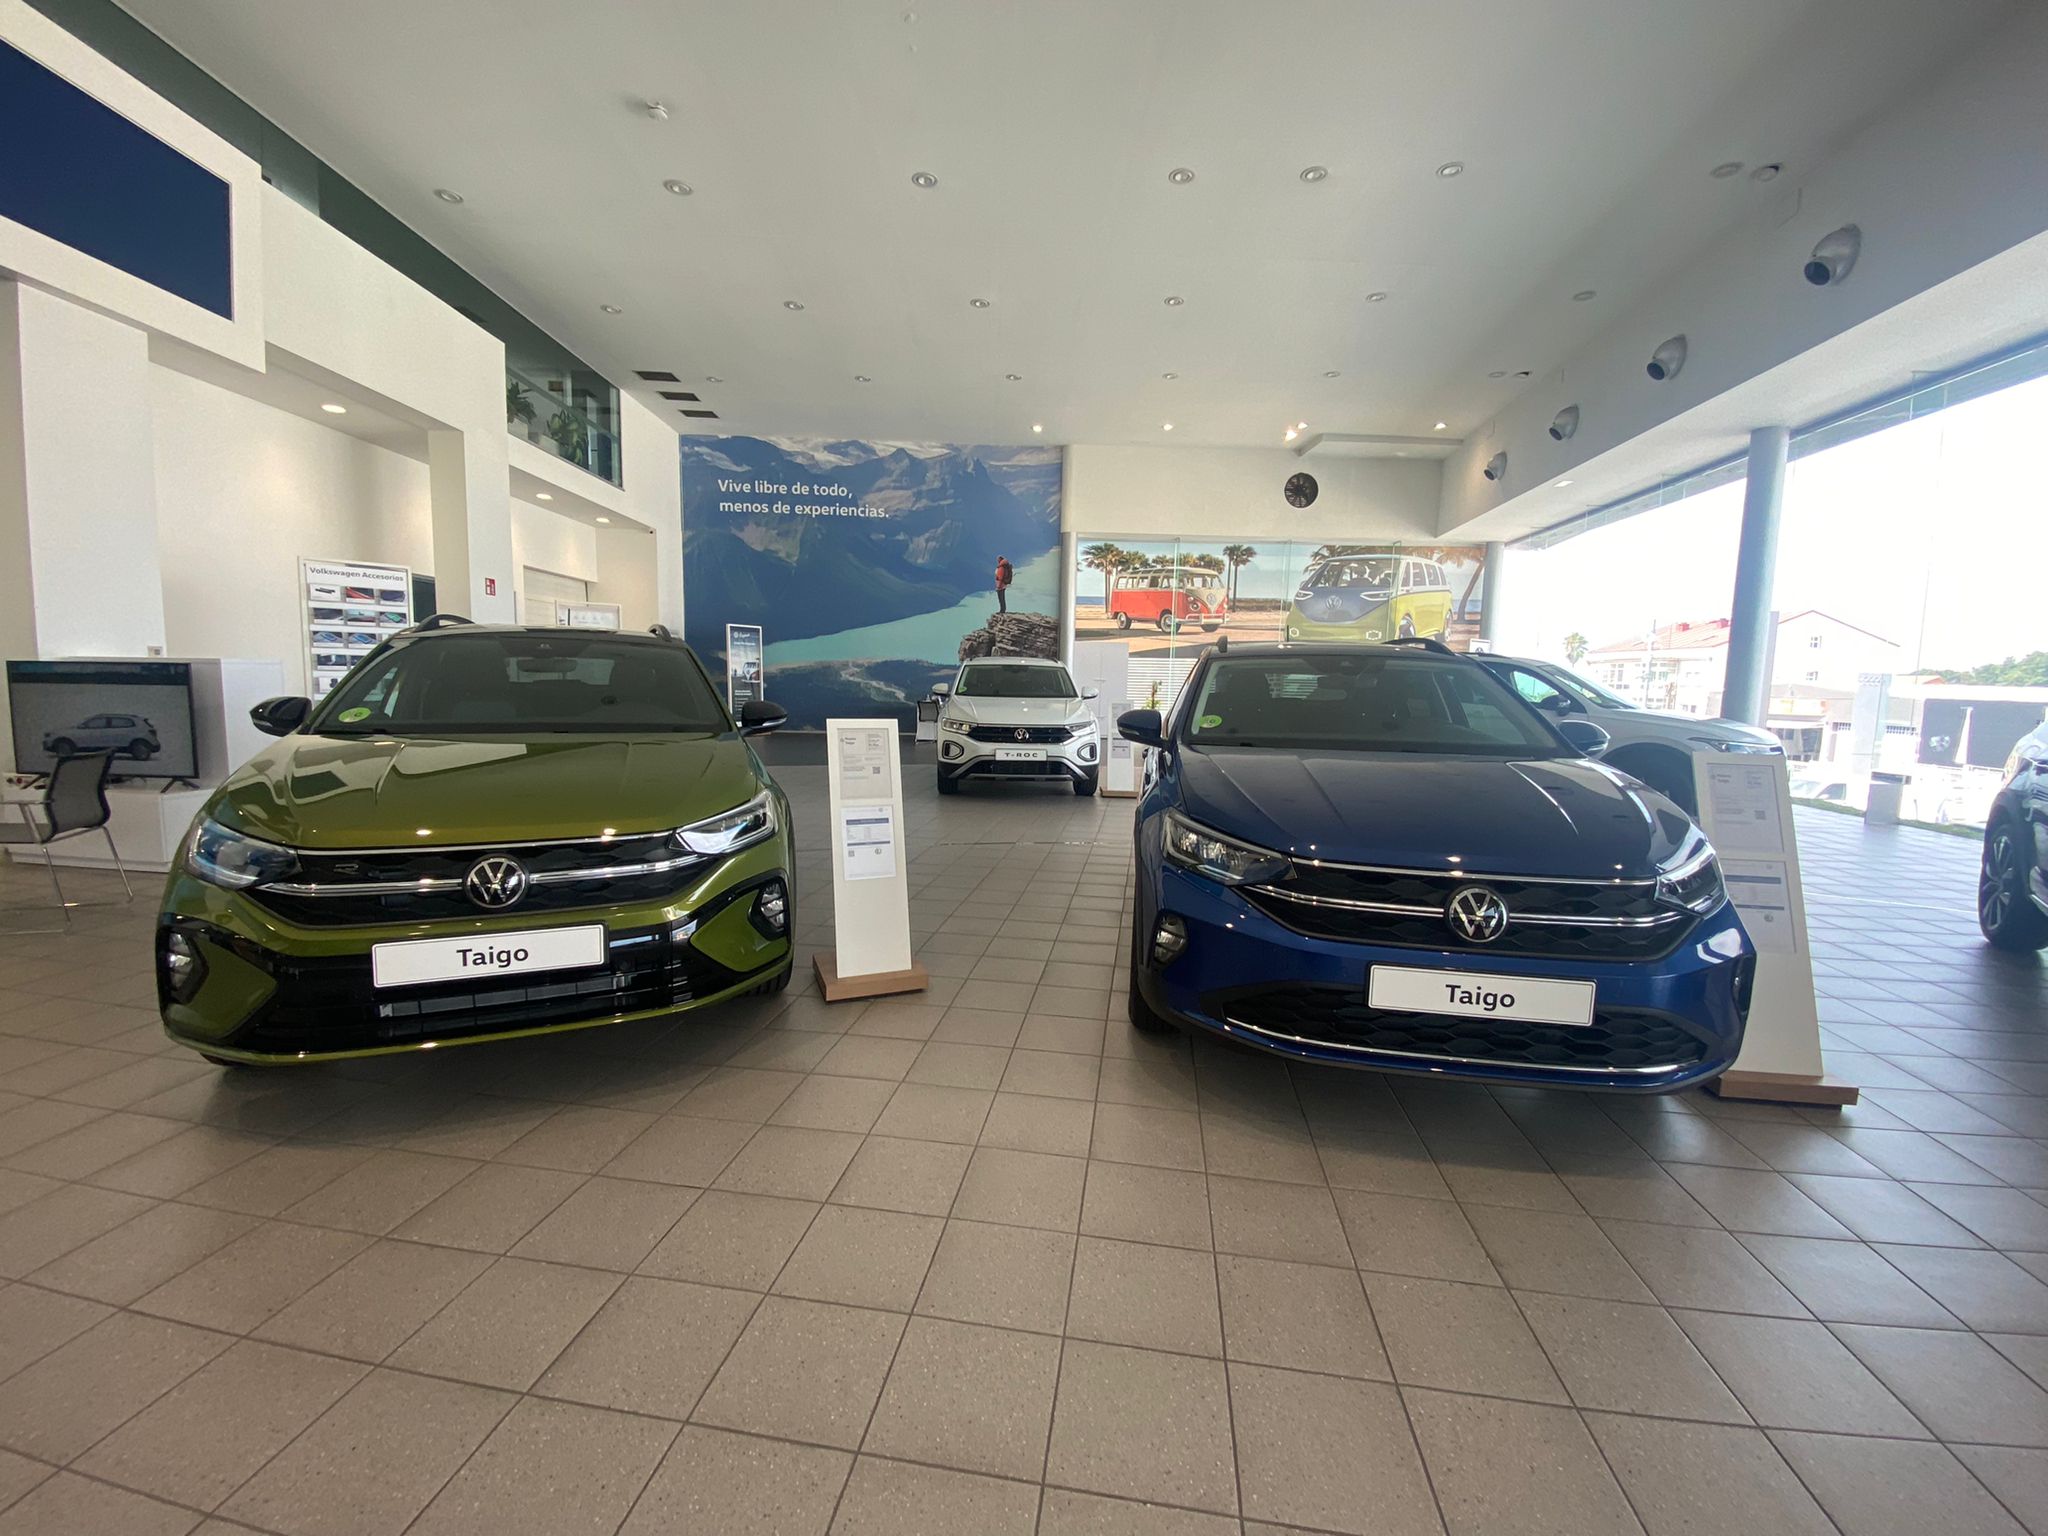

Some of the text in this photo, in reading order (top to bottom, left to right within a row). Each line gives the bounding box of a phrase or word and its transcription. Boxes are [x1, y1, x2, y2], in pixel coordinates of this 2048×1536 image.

[717, 479, 853, 499] Vive libre de todo,
[719, 501, 889, 518] menos de experiencias.
[309, 567, 404, 582] Volkswagen Accesorios
[456, 946, 529, 968] Taigo
[1445, 984, 1515, 1011] Taigo
